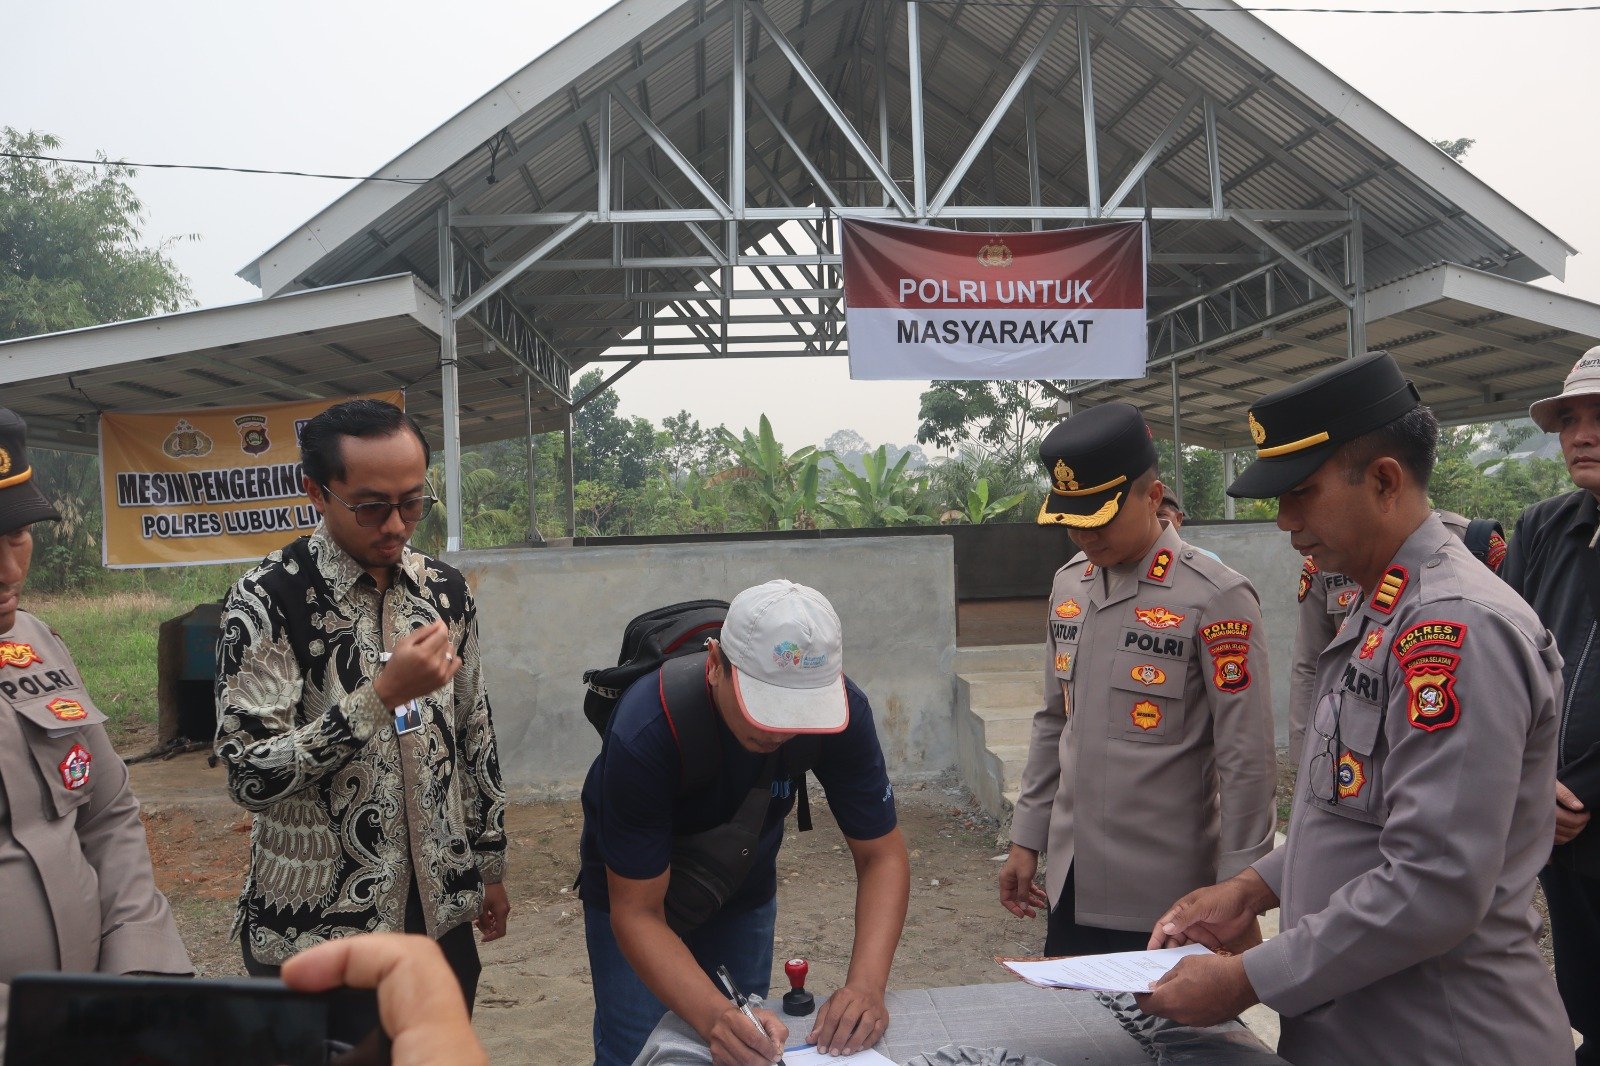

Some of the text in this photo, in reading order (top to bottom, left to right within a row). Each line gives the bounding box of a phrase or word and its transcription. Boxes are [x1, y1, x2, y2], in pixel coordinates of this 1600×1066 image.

[899, 278, 1093, 304] POLRI UNTUK
[897, 319, 1094, 344] MASYARAKAT
[117, 471, 191, 505] MESIN
[143, 512, 221, 538] POLRES
[224, 507, 293, 533] LUBUK
[1203, 622, 1248, 636] POLRES
[1400, 625, 1453, 647] POLRES
[1124, 631, 1184, 657] POLRI
[1399, 633, 1457, 657] LUBUK LINGGAU
[0, 669, 74, 700] POLRI
